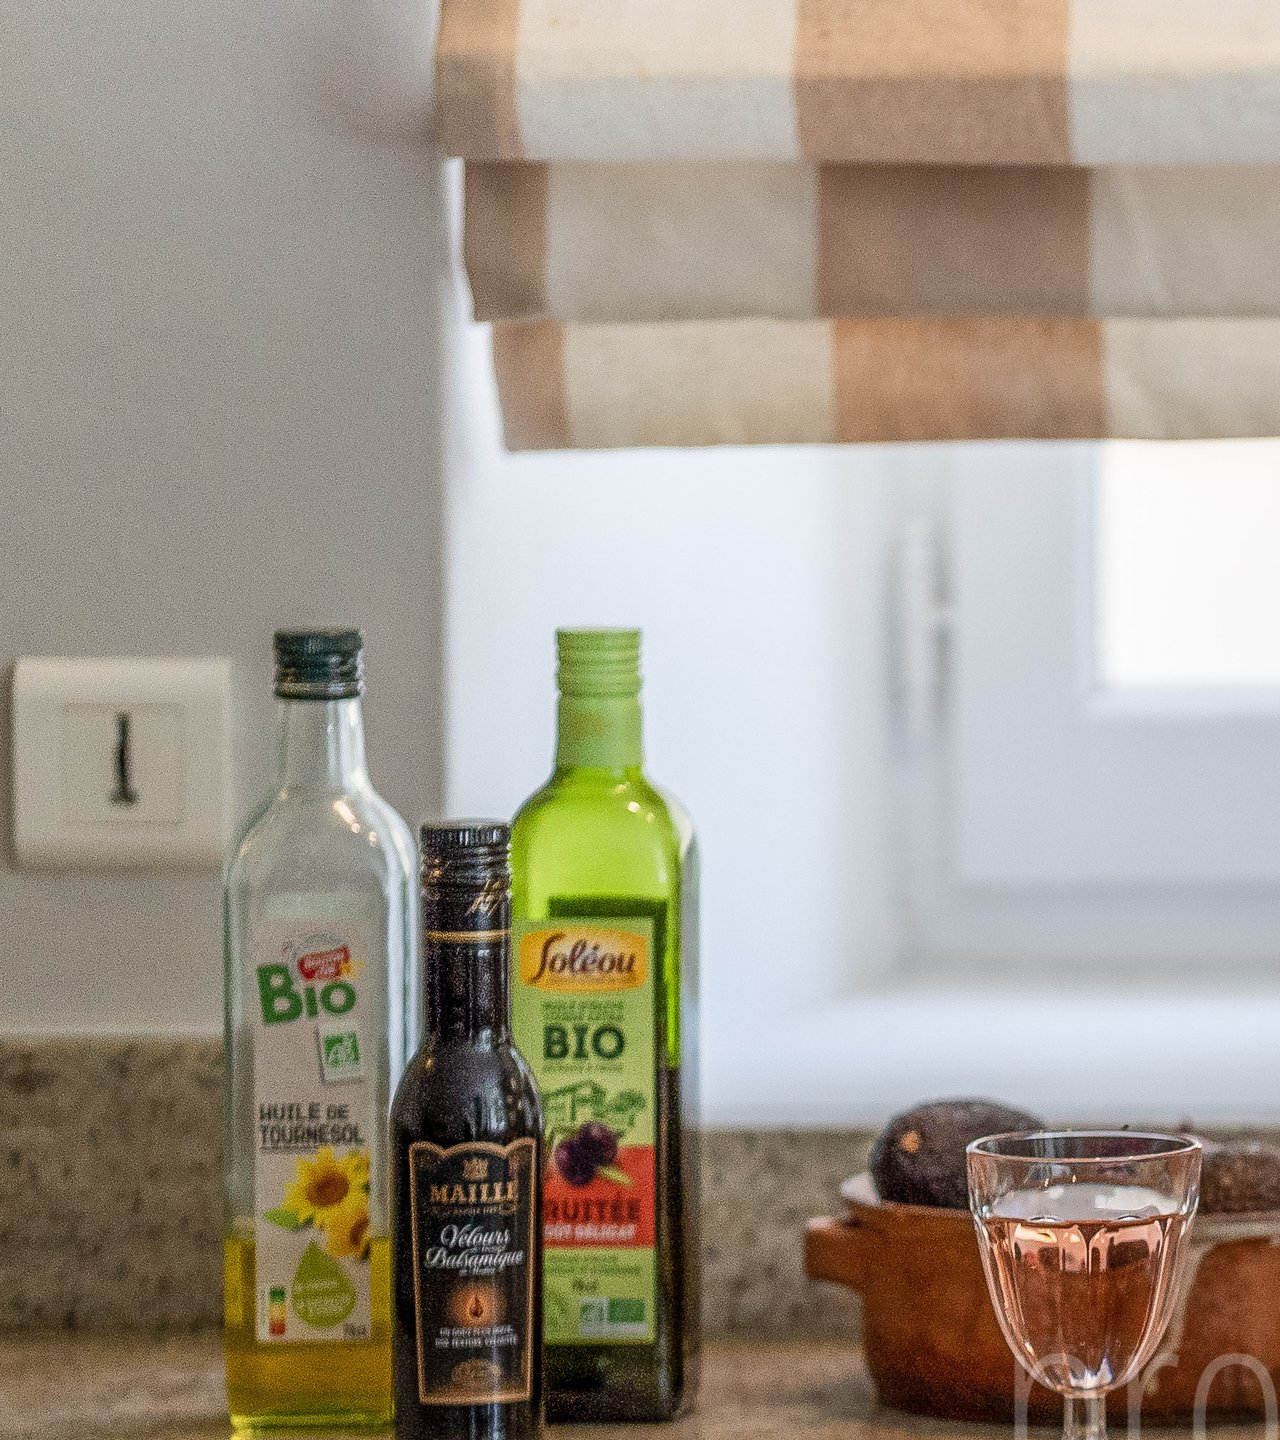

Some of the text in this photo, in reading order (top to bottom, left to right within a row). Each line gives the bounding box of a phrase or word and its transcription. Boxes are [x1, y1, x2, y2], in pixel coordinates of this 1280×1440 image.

[527, 932, 636, 985] Soléou
[543, 1023, 626, 1061] BIO
[259, 1101, 350, 1121] HUILE DE
[259, 1122, 366, 1147] TOURNESOL
[439, 1223, 512, 1249] Velours
